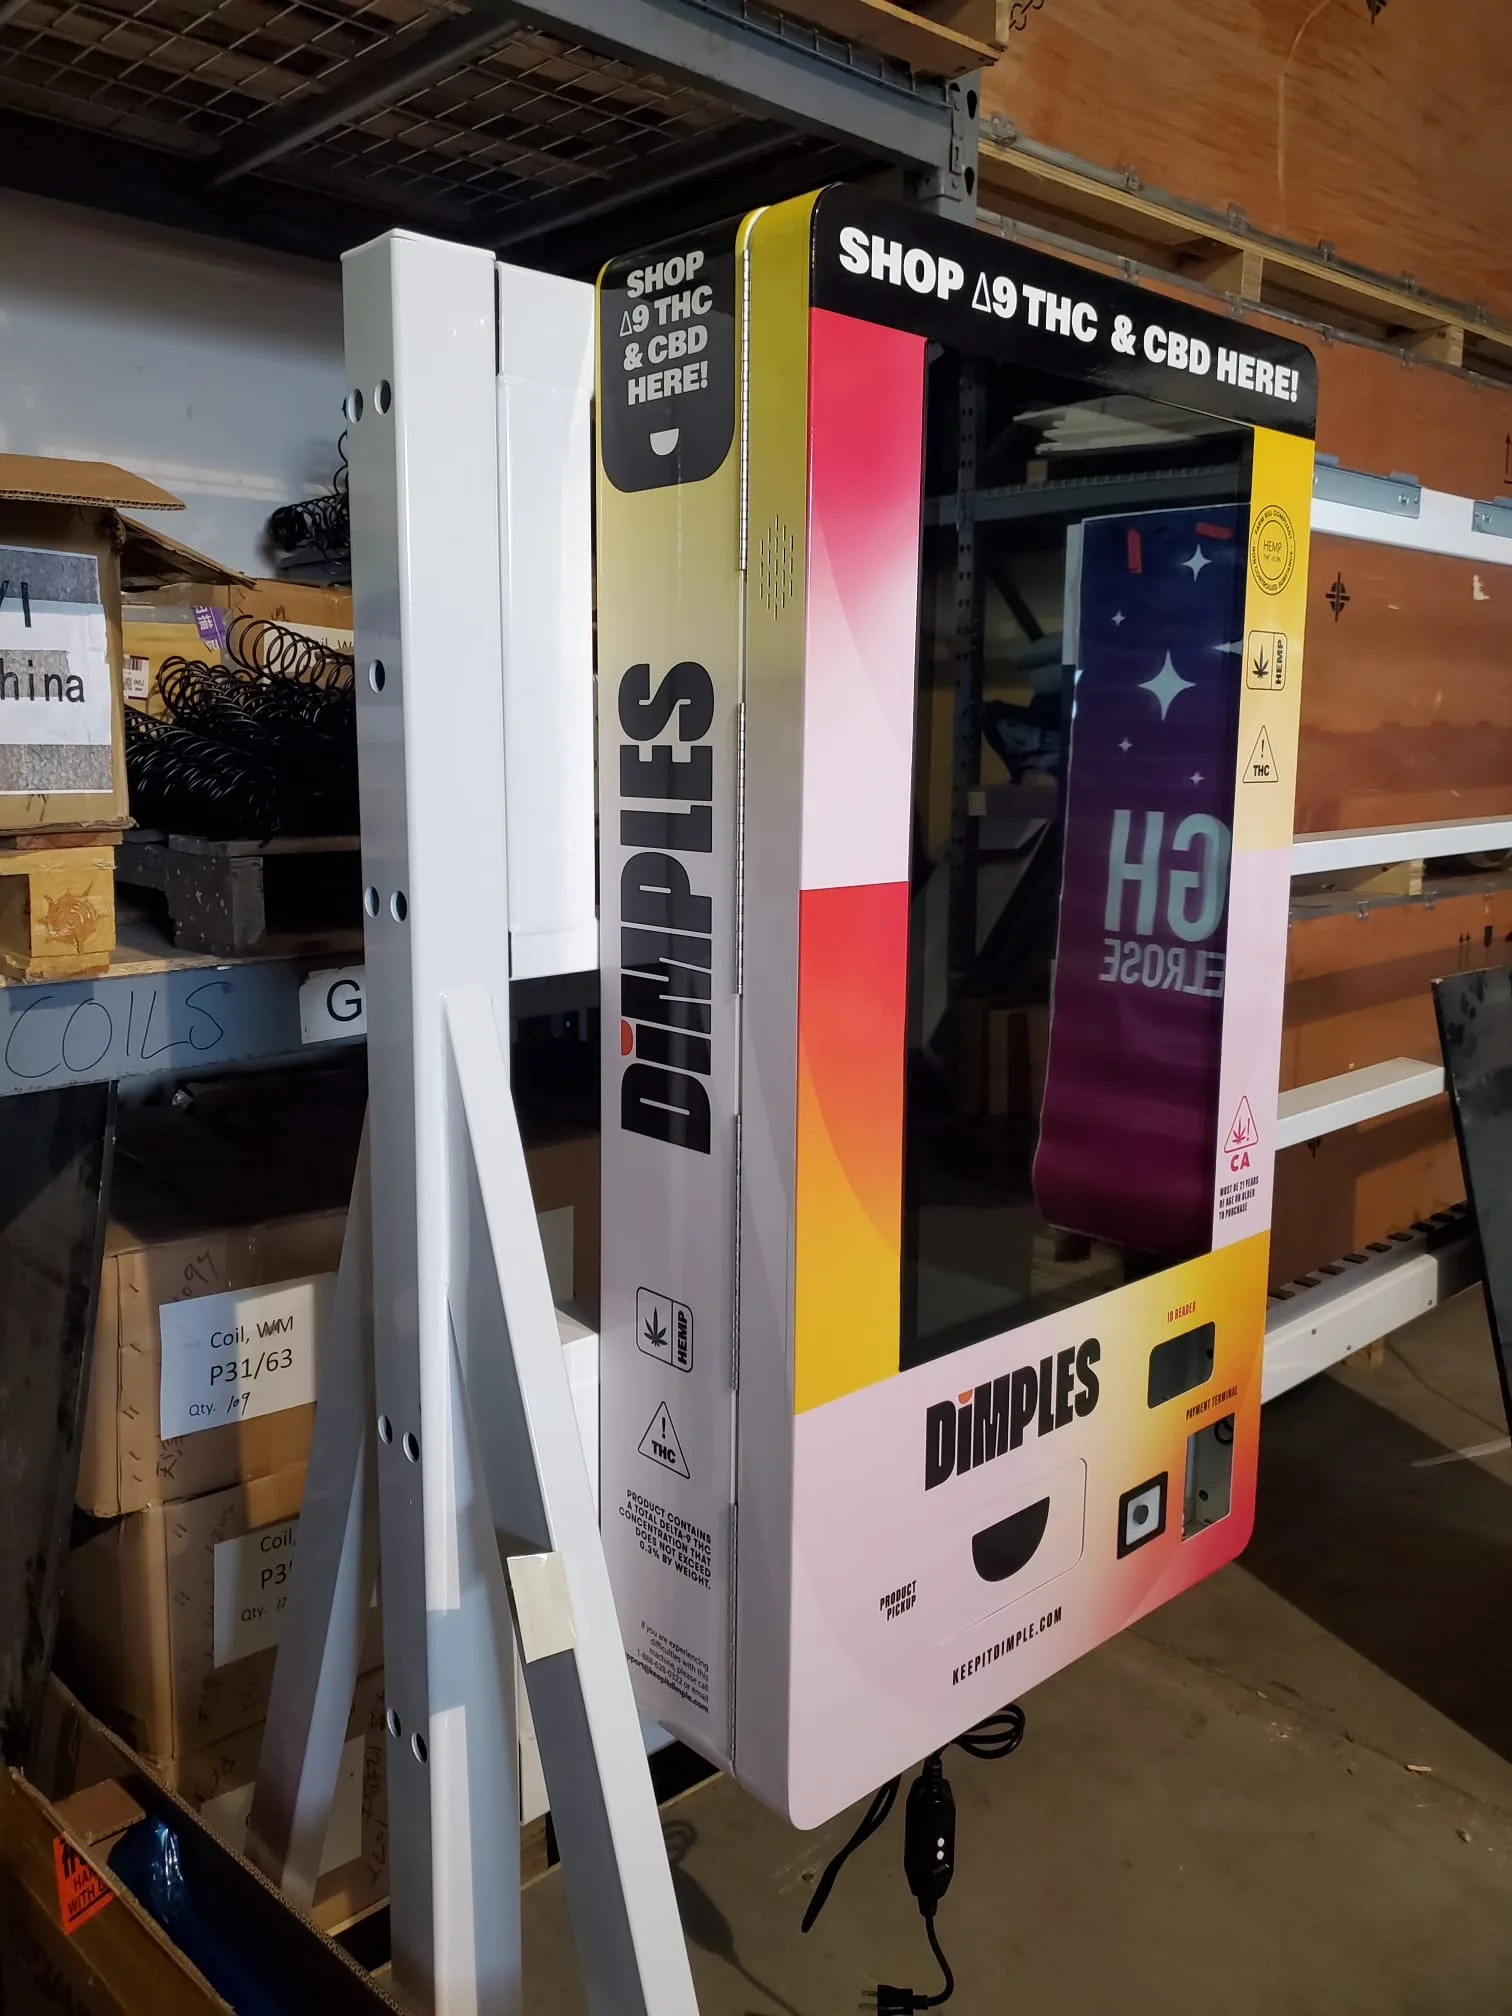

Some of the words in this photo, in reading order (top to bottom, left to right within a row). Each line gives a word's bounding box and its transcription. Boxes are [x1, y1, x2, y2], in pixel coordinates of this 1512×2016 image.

[627, 250, 704, 298] SHOP
[654, 285, 713, 326] THC
[838, 226, 964, 300] SHOP
[1022, 283, 1098, 342] THC
[1111, 314, 1136, 355] &
[1143, 325, 1211, 375] CBD
[1217, 347, 1299, 403] HERE!
[623, 342, 643, 371] &
[647, 325, 708, 364] CBD
[627, 360, 709, 406] HERE!
[1263, 540, 1282, 553] HEMP
[0, 657, 85, 703] hina
[1275, 639, 1284, 685] HEMP
[1253, 765, 1270, 777] THC
[326, 979, 363, 1022] G
[5, 981, 232, 1078] COILS
[1230, 1152, 1250, 1172] CA
[1219, 1184, 1233, 1197] MUST
[1233, 1182, 1239, 1192] BE
[1240, 1180, 1245, 1190] 21
[1245, 1176, 1259, 1188] YEARS
[1219, 1198, 1225, 1208] OF
[1225, 1195, 1235, 1206] AGE
[1235, 1193, 1241, 1203] OR
[1241, 1188, 1255, 1202] OLDER
[1218, 1210, 1225, 1220] TO
[1225, 1202, 1248, 1219] PURCHASE
[1167, 1310, 1174, 1323] ID
[1174, 1301, 1196, 1319] READER
[210, 1325, 250, 1349] Coil,
[677, 1310, 688, 1365] HEMP
[209, 1348, 293, 1386] P31/63
[188, 1402, 216, 1418] Qty.
[1185, 1399, 1210, 1421] PAYMENT
[1211, 1385, 1238, 1407] TERMINAL
[651, 1439, 676, 1464] THC
[619, 1507, 688, 1553] CONCENTRATION
[690, 1547, 711, 1567] THAT
[627, 1489, 665, 1517] PRODUCT
[667, 1513, 711, 1544] CONTAINS
[627, 1501, 632, 1510] A
[634, 1504, 657, 1525] TOTAL
[660, 1519, 691, 1543] DELTA-9
[693, 1538, 711, 1555] THC
[635, 1527, 657, 1546] DOES
[659, 1541, 676, 1557] NOT
[678, 1552, 711, 1578] EXCEED
[639, 1540, 660, 1559] 0.3%
[662, 1554, 672, 1566] BY
[675, 1561, 711, 1590] WEIGHT.
[261, 1561, 293, 1590] P3
[879, 1580, 917, 1611] PRODUCT
[886, 1594, 917, 1621] PICKUP
[646, 1624, 657, 1637] you
[658, 1633, 668, 1644] are
[669, 1640, 709, 1673] experiencing
[650, 1638, 681, 1663] difficulties
[682, 1660, 696, 1673] with
[697, 1668, 709, 1681] this
[952, 1606, 1063, 1686] KEEPITDIMPLE.COM
[649, 1648, 676, 1672] machine,
[677, 1667, 697, 1684] please
[698, 1681, 709, 1692] call
[683, 1681, 691, 1690] or
[691, 1687, 709, 1703] email
[68, 1884, 96, 1915] WITH
